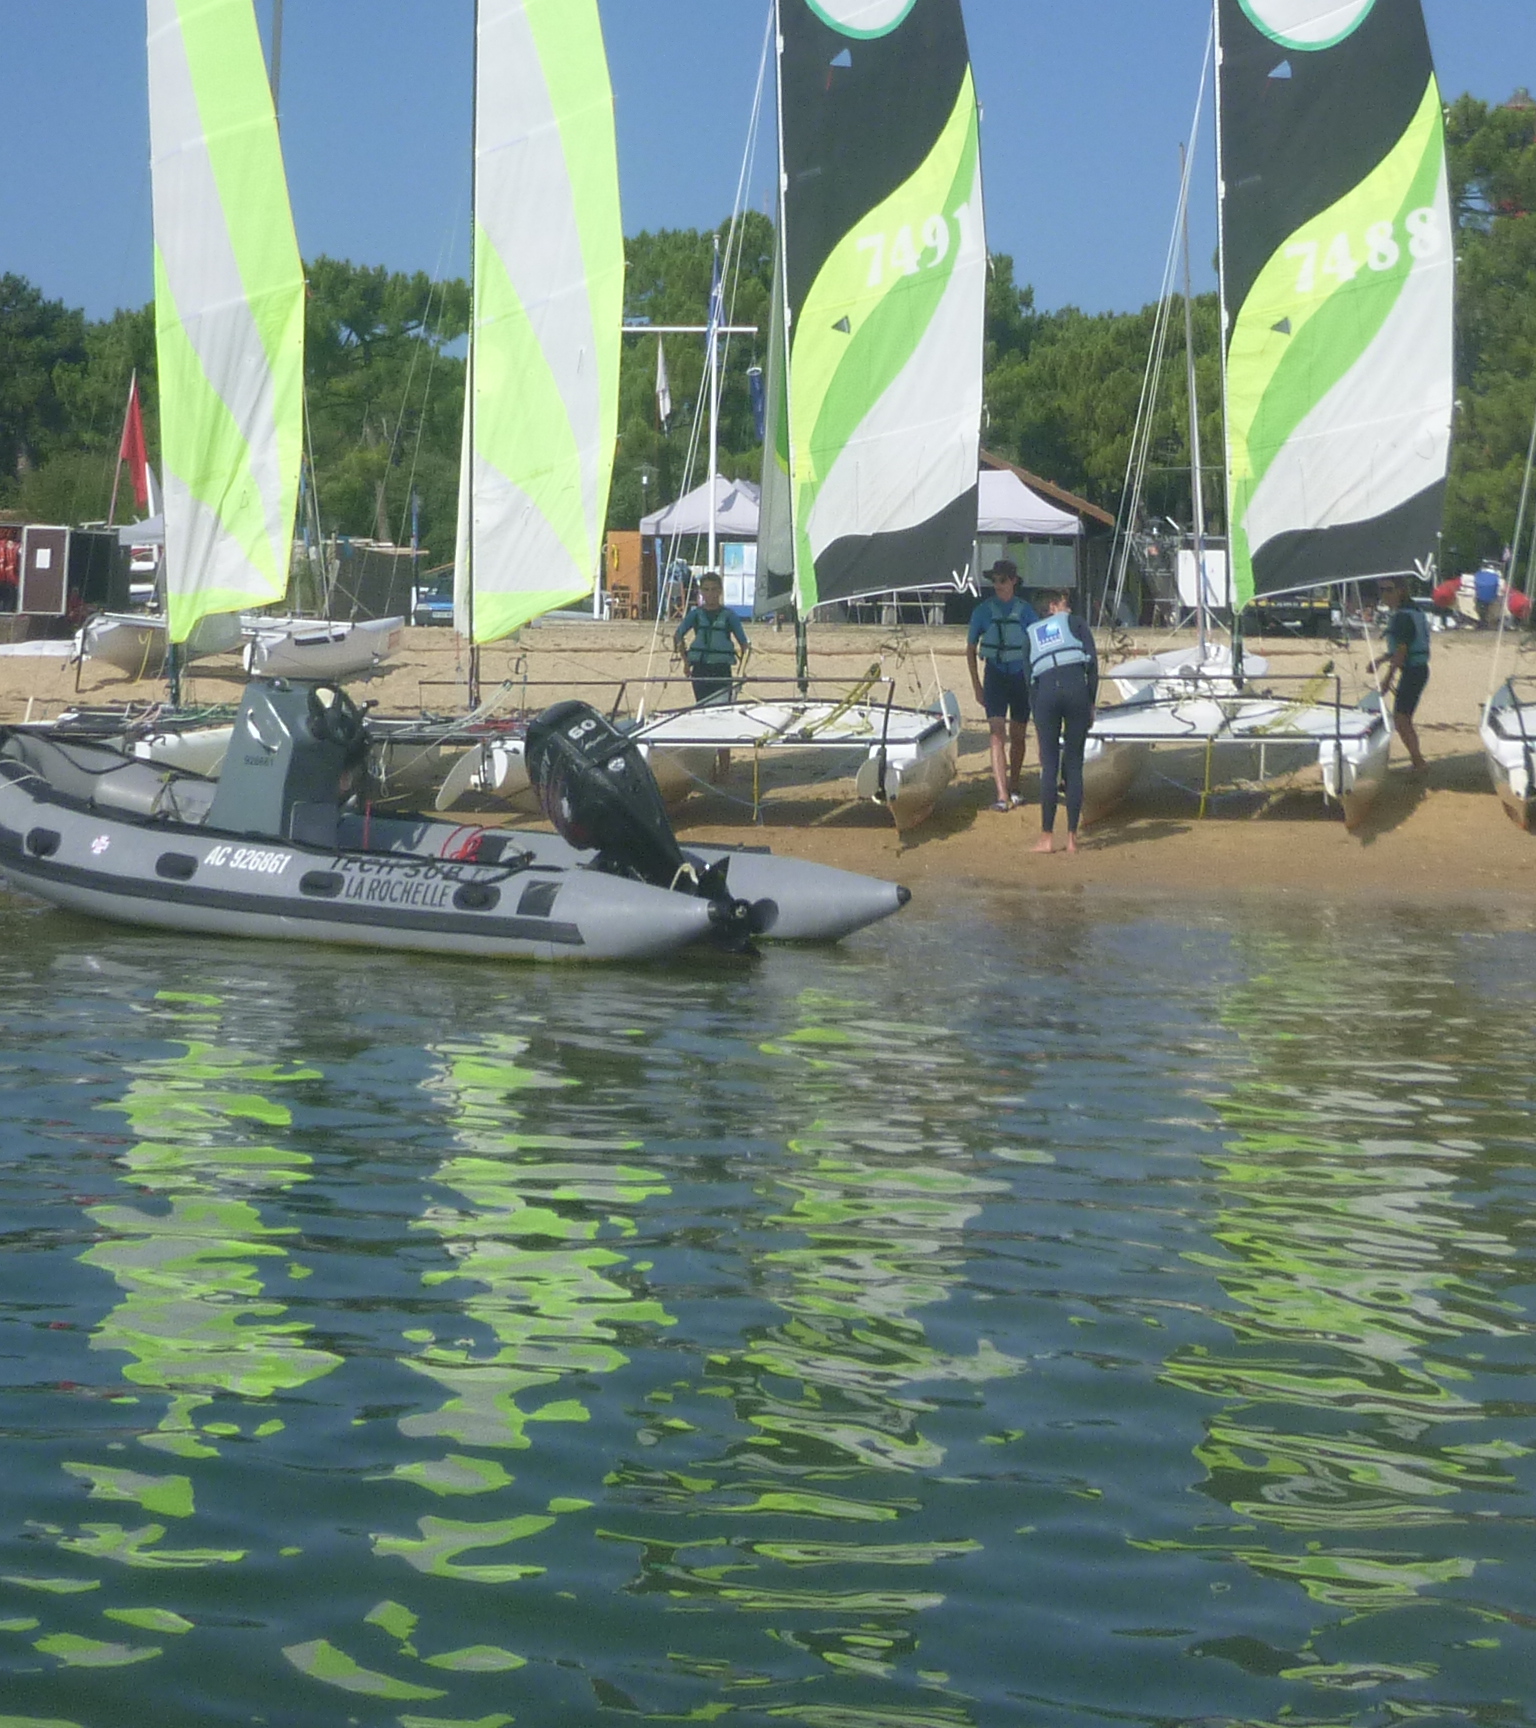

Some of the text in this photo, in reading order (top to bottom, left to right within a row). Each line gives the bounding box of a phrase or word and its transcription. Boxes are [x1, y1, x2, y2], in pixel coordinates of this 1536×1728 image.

[856, 201, 976, 288] 7491
[1284, 206, 1442, 294] 7488
[567, 719, 597, 739] 60
[203, 845, 292, 875] AC 926861
[344, 876, 451, 908] LA ROCHELLE
